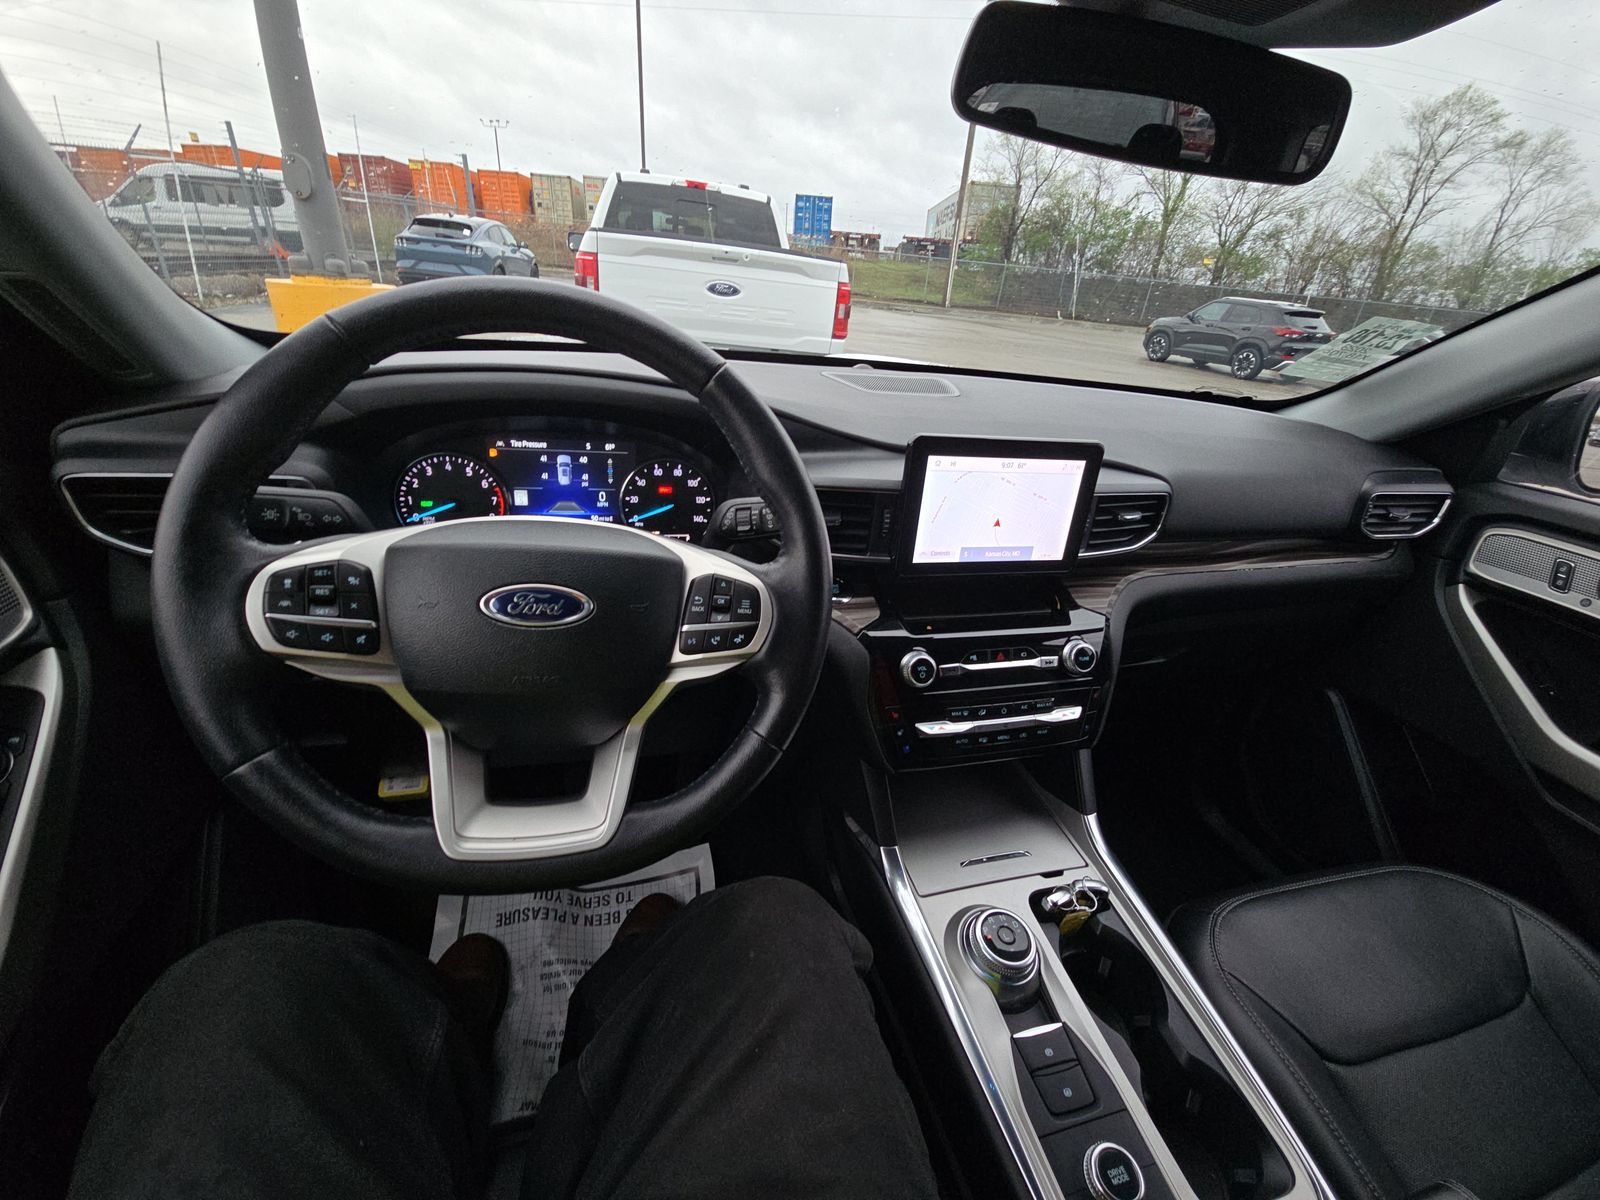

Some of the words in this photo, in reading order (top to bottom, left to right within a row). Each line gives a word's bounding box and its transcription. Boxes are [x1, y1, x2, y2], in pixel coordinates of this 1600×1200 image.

[510, 440, 522, 448] Tire
[522, 440, 547, 449] Pressure
[579, 456, 588, 464] 40
[445, 462, 452, 471] 4
[1001, 461, 1014, 469] 9:07
[425, 466, 432, 476] 3
[465, 468, 473, 477] 5
[653, 468, 663, 476] 60
[673, 468, 682, 476] 80
[541, 472, 548, 480] 41
[412, 478, 419, 488] 2
[481, 479, 489, 488] 6
[636, 479, 646, 487] 40
[408, 495, 413, 505] 1
[491, 496, 497, 505] 7
[598, 491, 606, 502] 0
[629, 495, 639, 503] 20
[695, 496, 706, 504] 120
[693, 515, 704, 523] 140
[315, 588, 329, 596] RES
[507, 591, 565, 616] Ford
[567, 891, 610, 909] SERVE
[616, 890, 634, 904] TO
[495, 906, 567, 928] PLEASURE
[571, 912, 579, 925] A
[584, 909, 621, 927] BEEN
[987, 916, 995, 924] R
[1011, 920, 1019, 929] D
[1107, 1165, 1126, 1178] DRIVE
[1111, 1173, 1130, 1186] MODE
